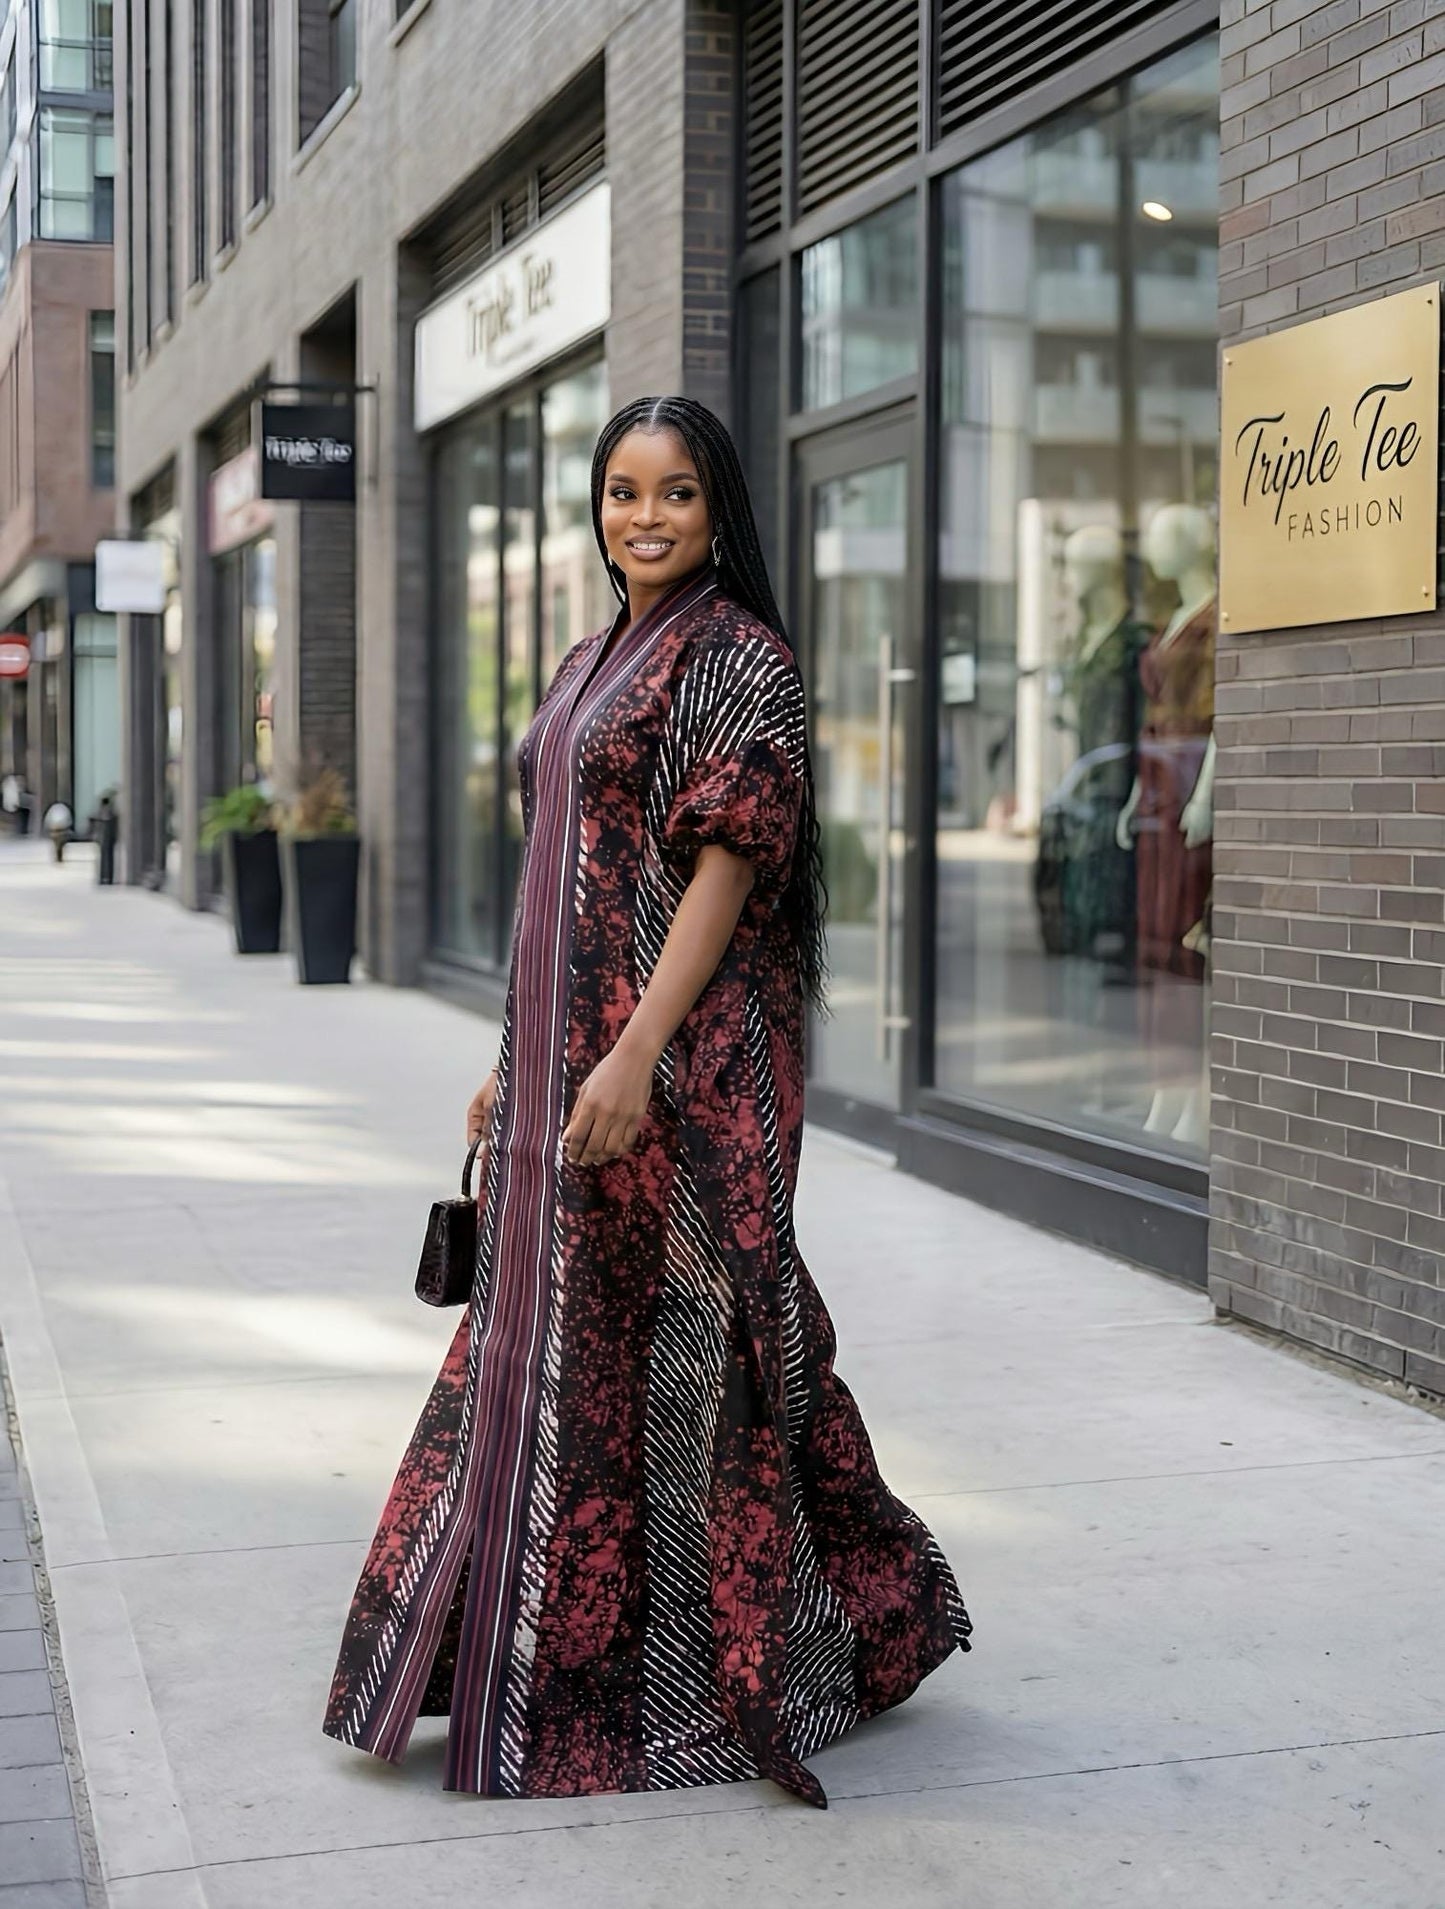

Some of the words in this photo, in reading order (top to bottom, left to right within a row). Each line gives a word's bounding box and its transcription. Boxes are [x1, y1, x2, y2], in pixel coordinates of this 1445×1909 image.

[1235, 405, 1342, 526] Triple
[1353, 376, 1422, 482] Tee
[1288, 495, 1403, 541] FASHION
